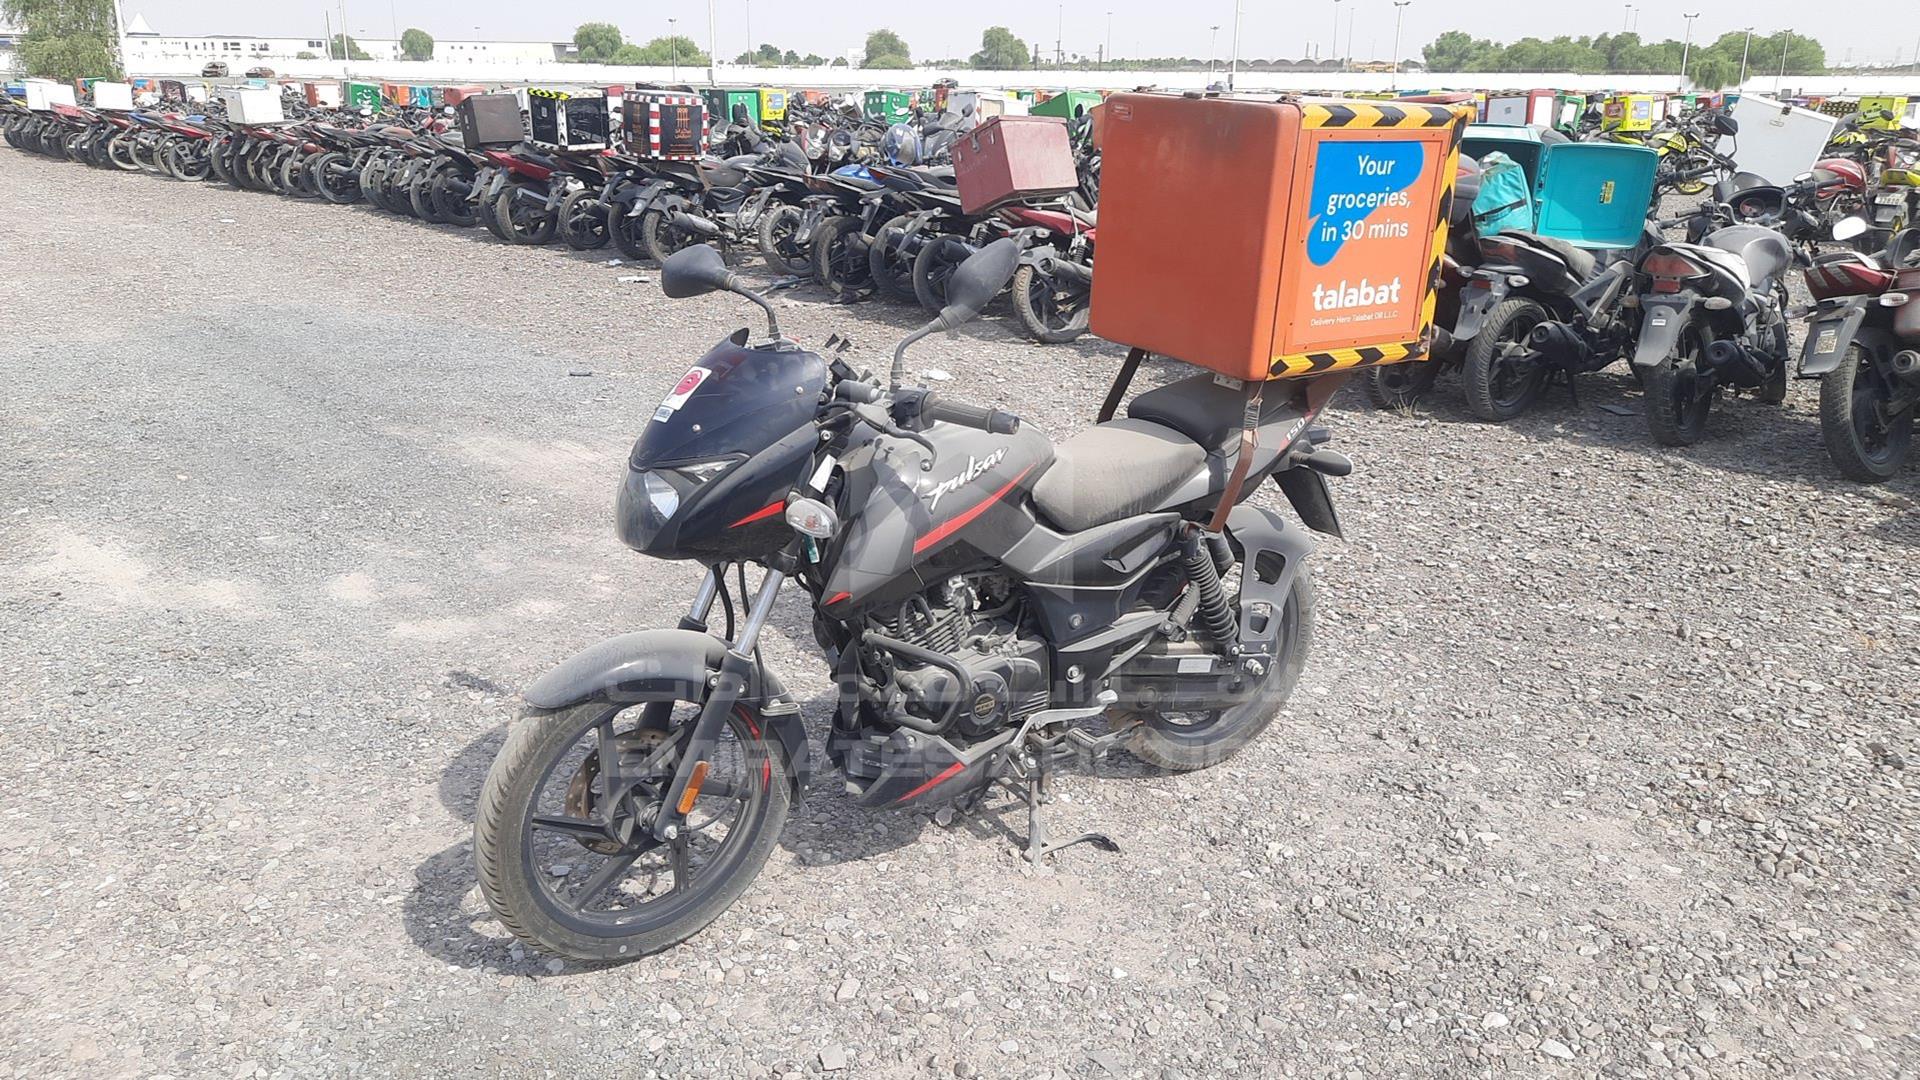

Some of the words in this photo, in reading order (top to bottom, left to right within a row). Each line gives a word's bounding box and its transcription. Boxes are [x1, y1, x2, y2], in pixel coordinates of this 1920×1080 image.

[1357, 154, 1396, 176] Your
[1326, 187, 1411, 216] groceries,
[1321, 221, 1338, 242] in
[1341, 220, 1366, 241] 30
[1367, 219, 1409, 240] mins
[1311, 276, 1401, 312] talabat
[1310, 317, 1336, 327] Delivery
[1352, 313, 1374, 322] Talabat
[1285, 416, 1306, 441] 150
